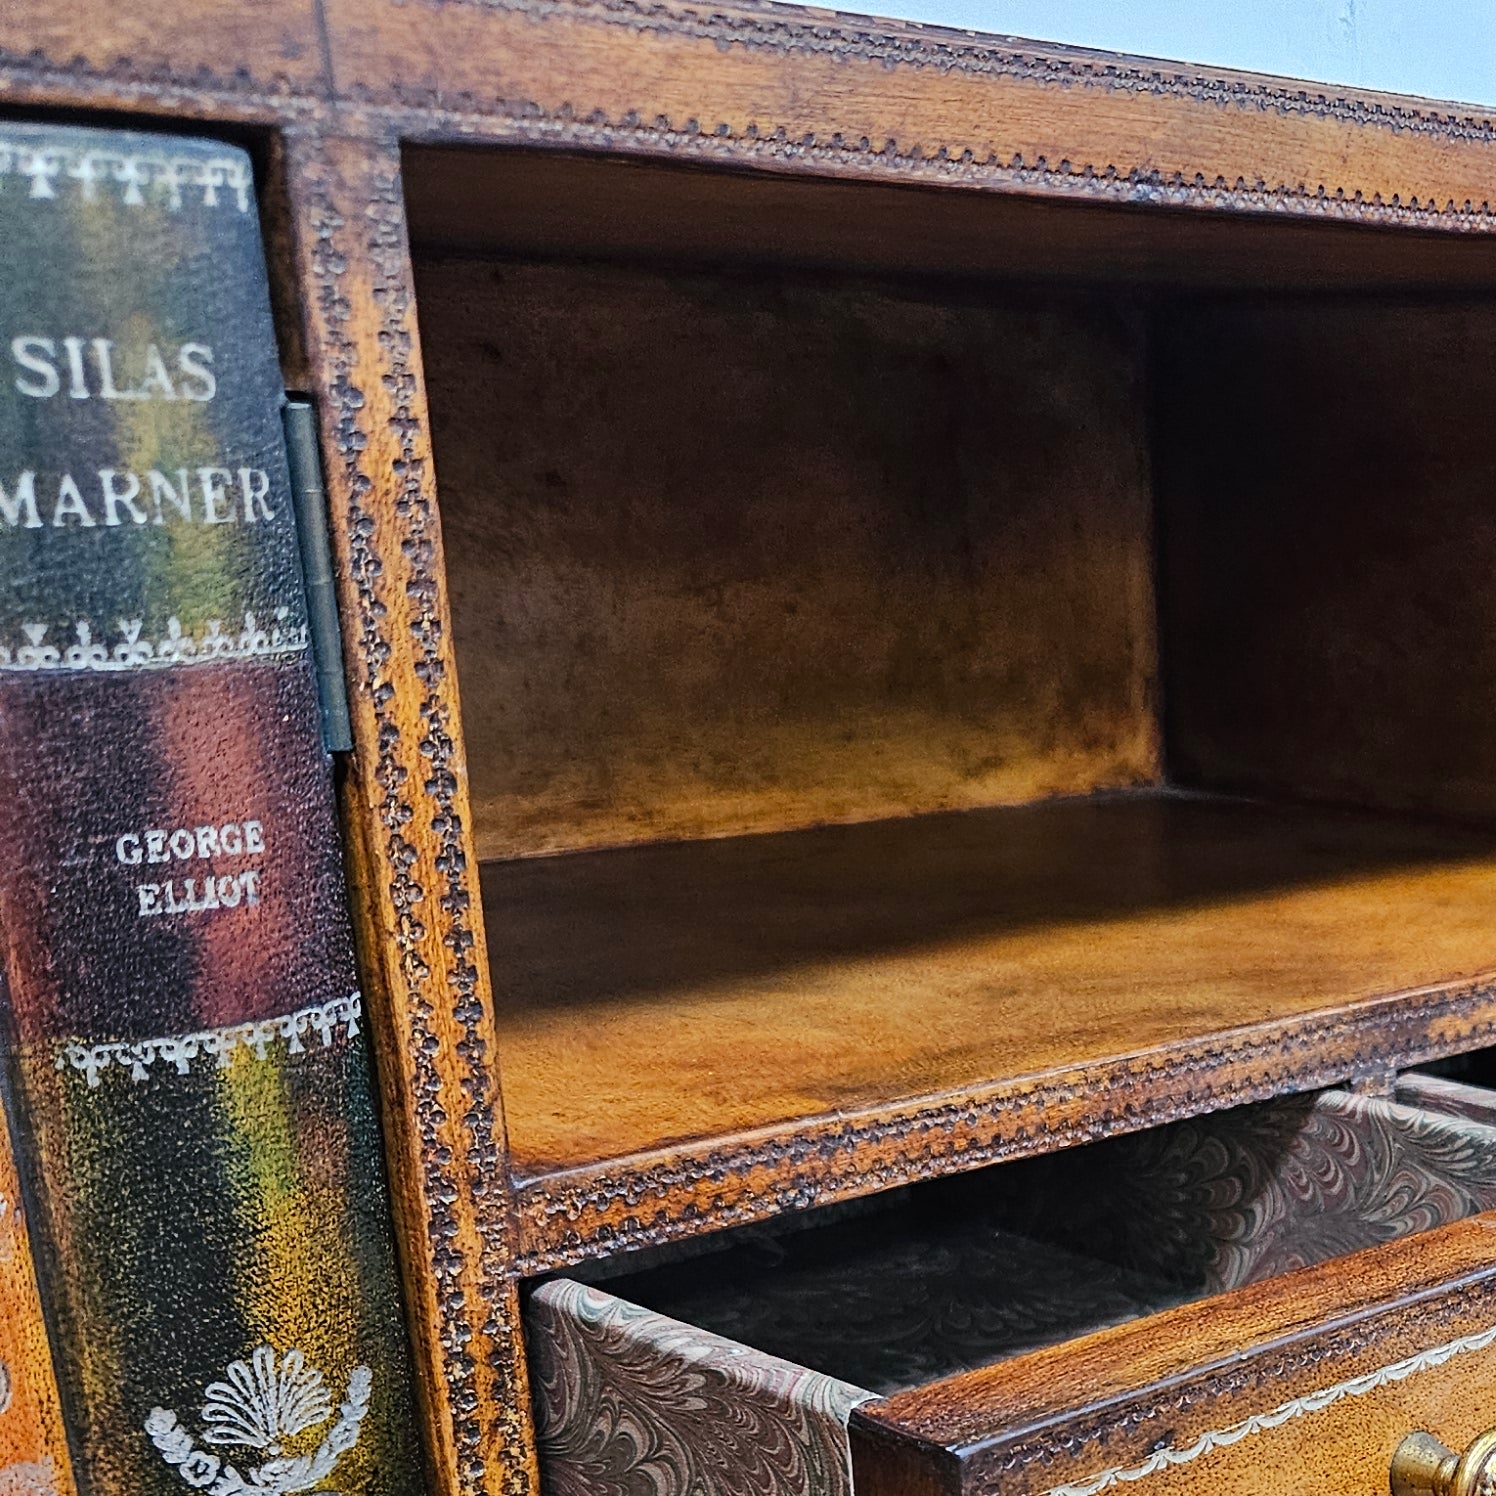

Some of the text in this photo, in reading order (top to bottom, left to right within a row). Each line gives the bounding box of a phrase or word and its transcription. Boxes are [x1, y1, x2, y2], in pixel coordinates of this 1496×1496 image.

[11, 335, 216, 401] SILAS
[0, 468, 275, 528] MARNER
[115, 820, 266, 865] GEORGE
[137, 871, 261, 917] ELLIOT
